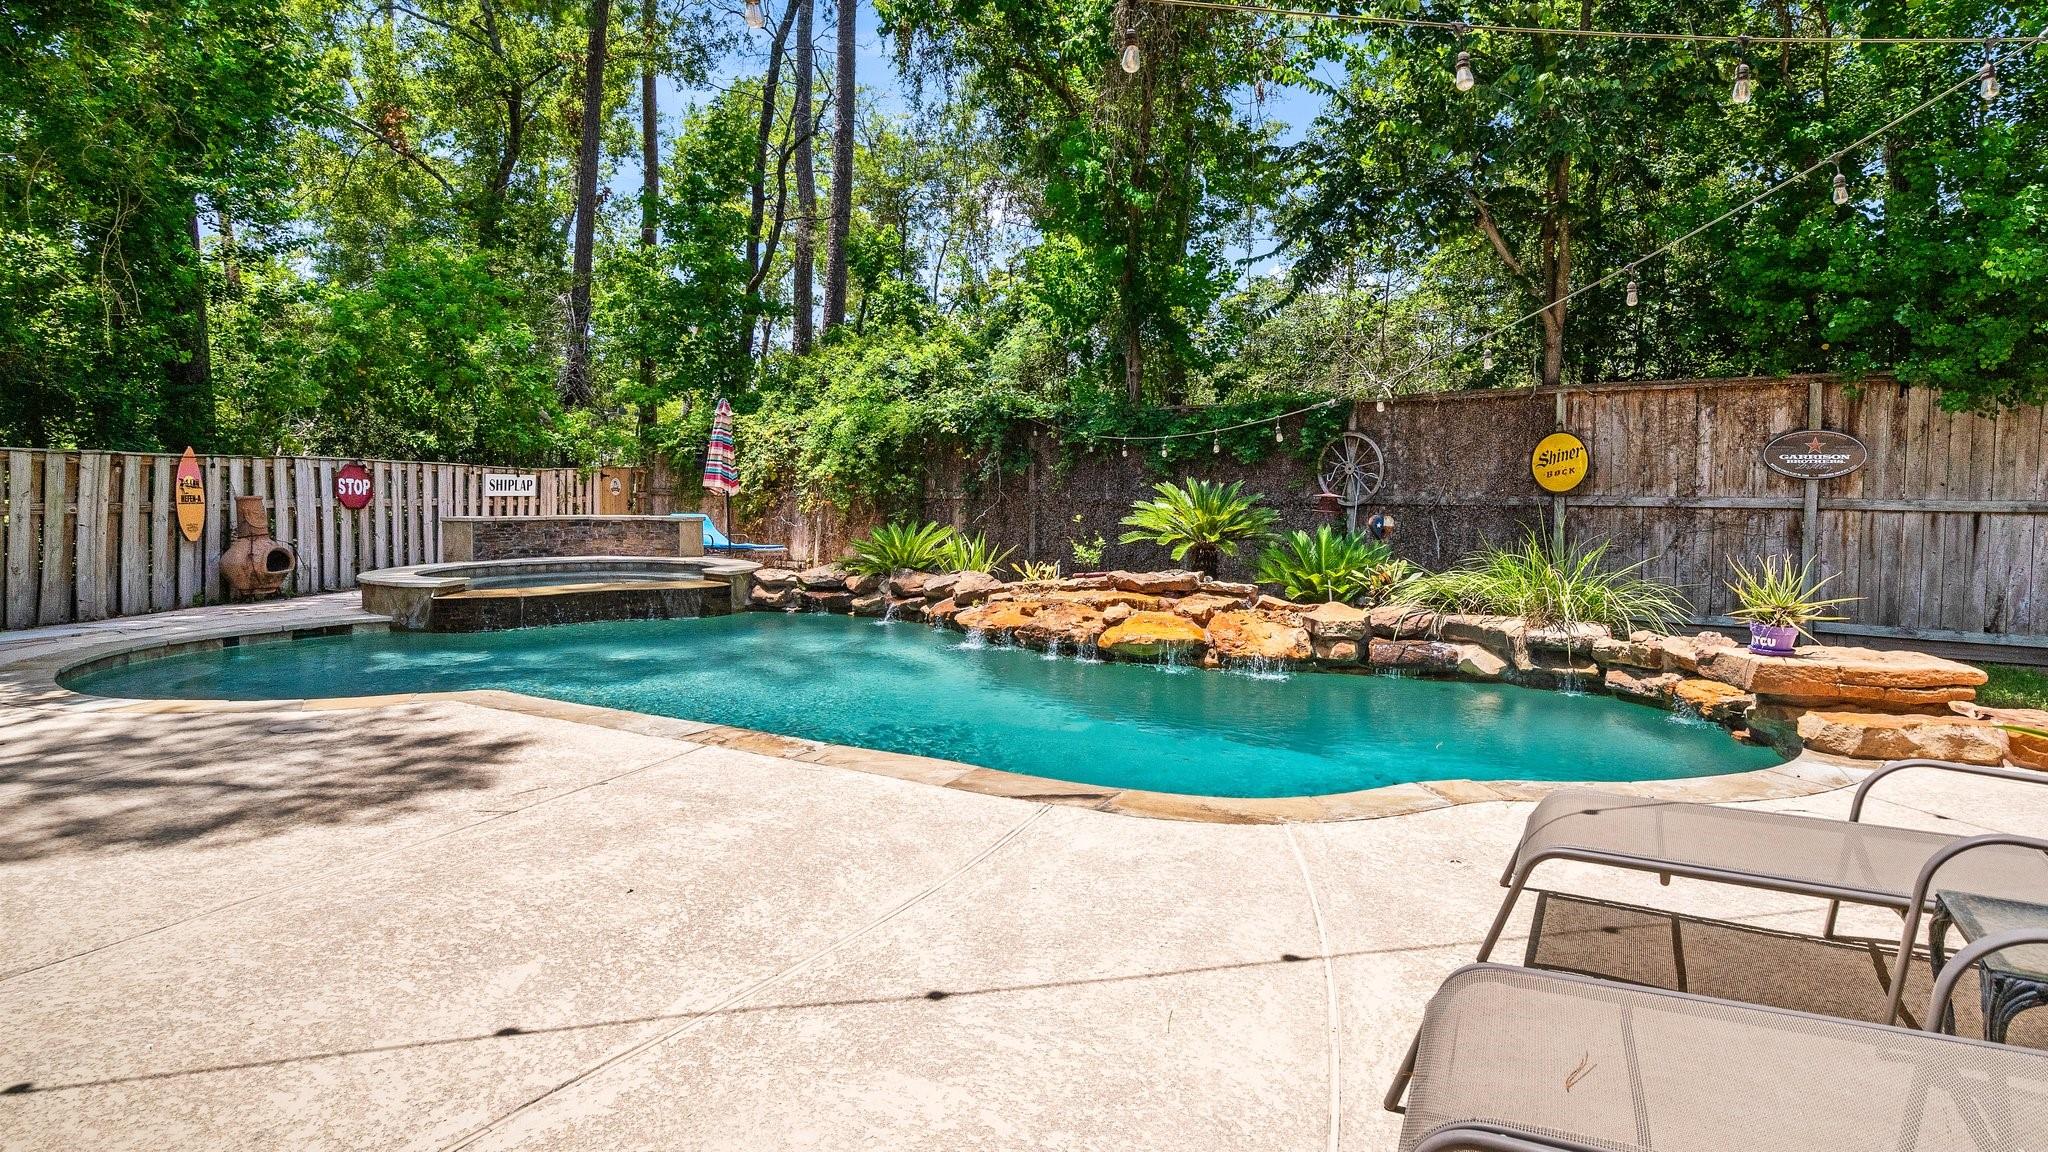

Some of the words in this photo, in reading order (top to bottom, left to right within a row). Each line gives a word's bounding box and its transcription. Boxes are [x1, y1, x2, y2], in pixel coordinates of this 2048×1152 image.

[1536, 447, 1584, 468] Shiner
[338, 477, 371, 496] STOP
[488, 478, 533, 492] SHIPLAP
[1753, 635, 1776, 647] TCU
